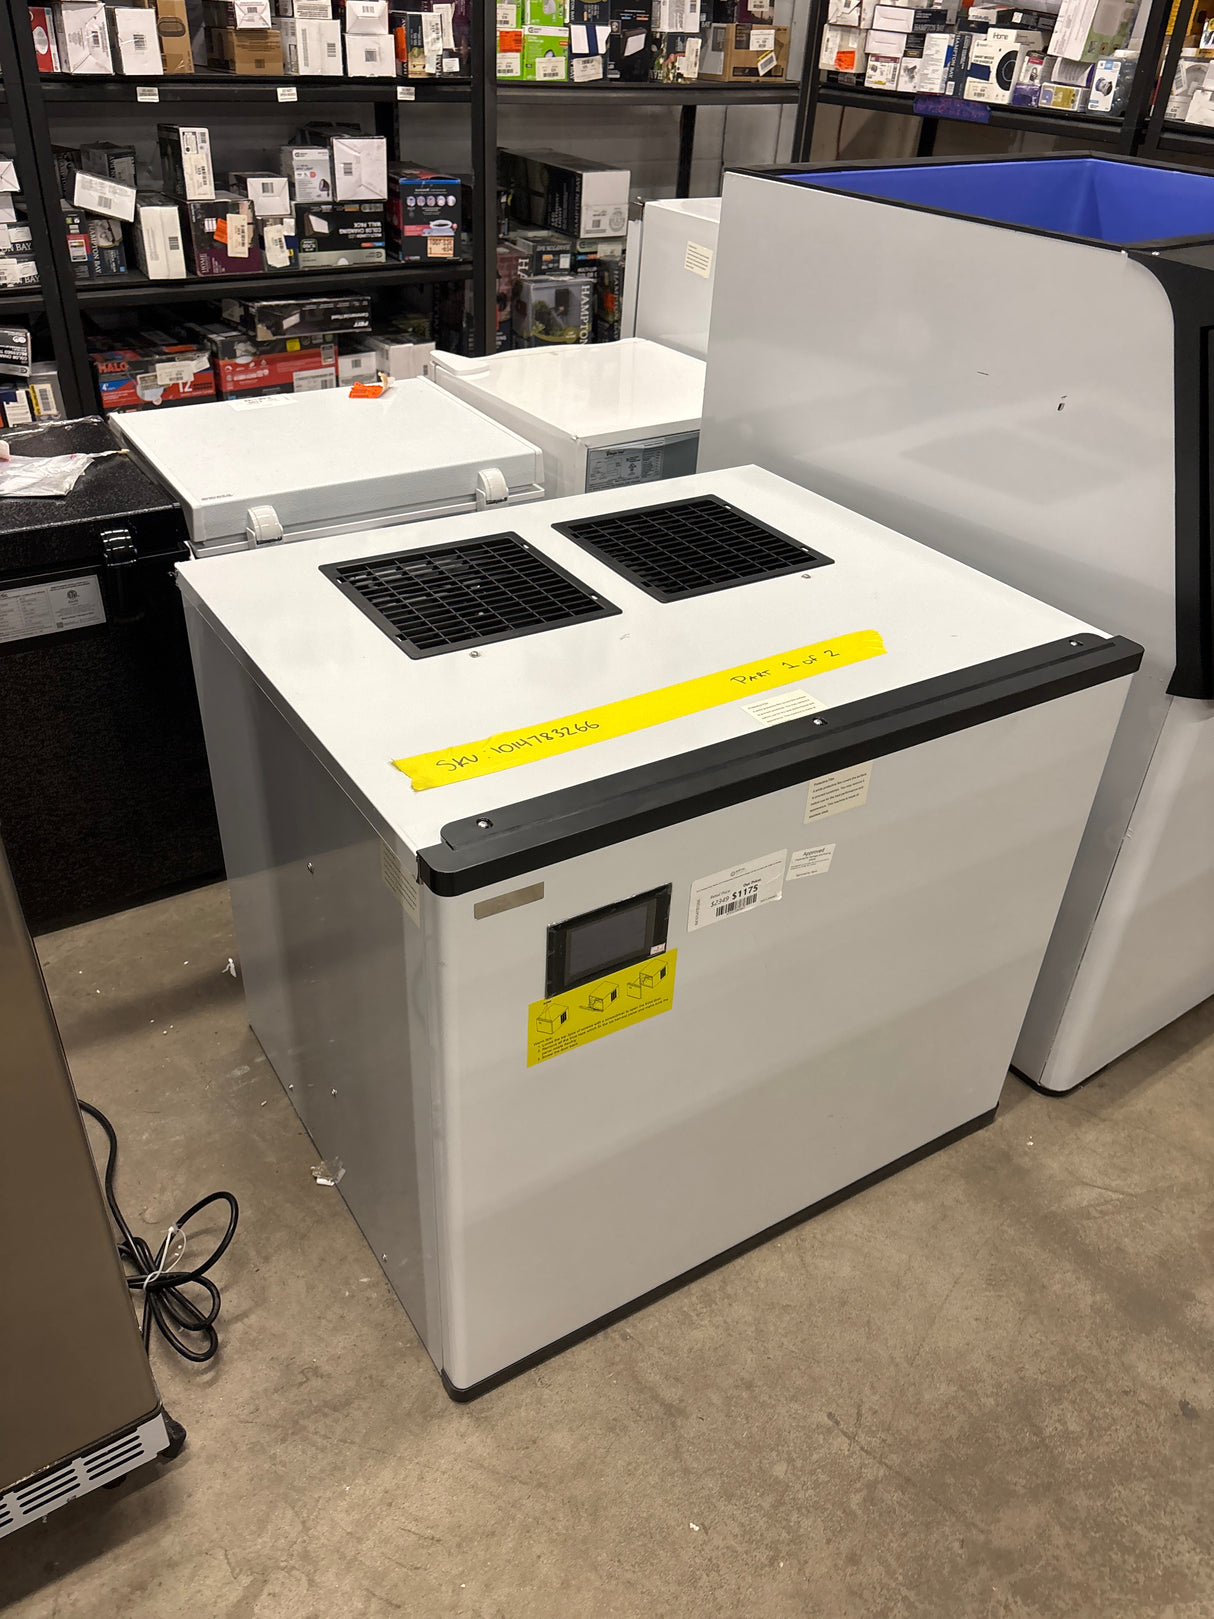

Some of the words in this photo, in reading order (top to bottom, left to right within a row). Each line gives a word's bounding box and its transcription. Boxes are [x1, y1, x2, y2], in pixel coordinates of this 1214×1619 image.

[950, 34, 961, 66] HAMPTON
[16, 242, 32, 251] BAY
[88, 224, 100, 259] HAMPTON
[24, 275, 40, 284] BAY
[98, 362, 128, 373] HALO
[730, 670, 771, 684] PART
[490, 720, 600, 754] 1014783266
[803, 847, 825, 856] Approved
[732, 884, 758, 900] $1175
